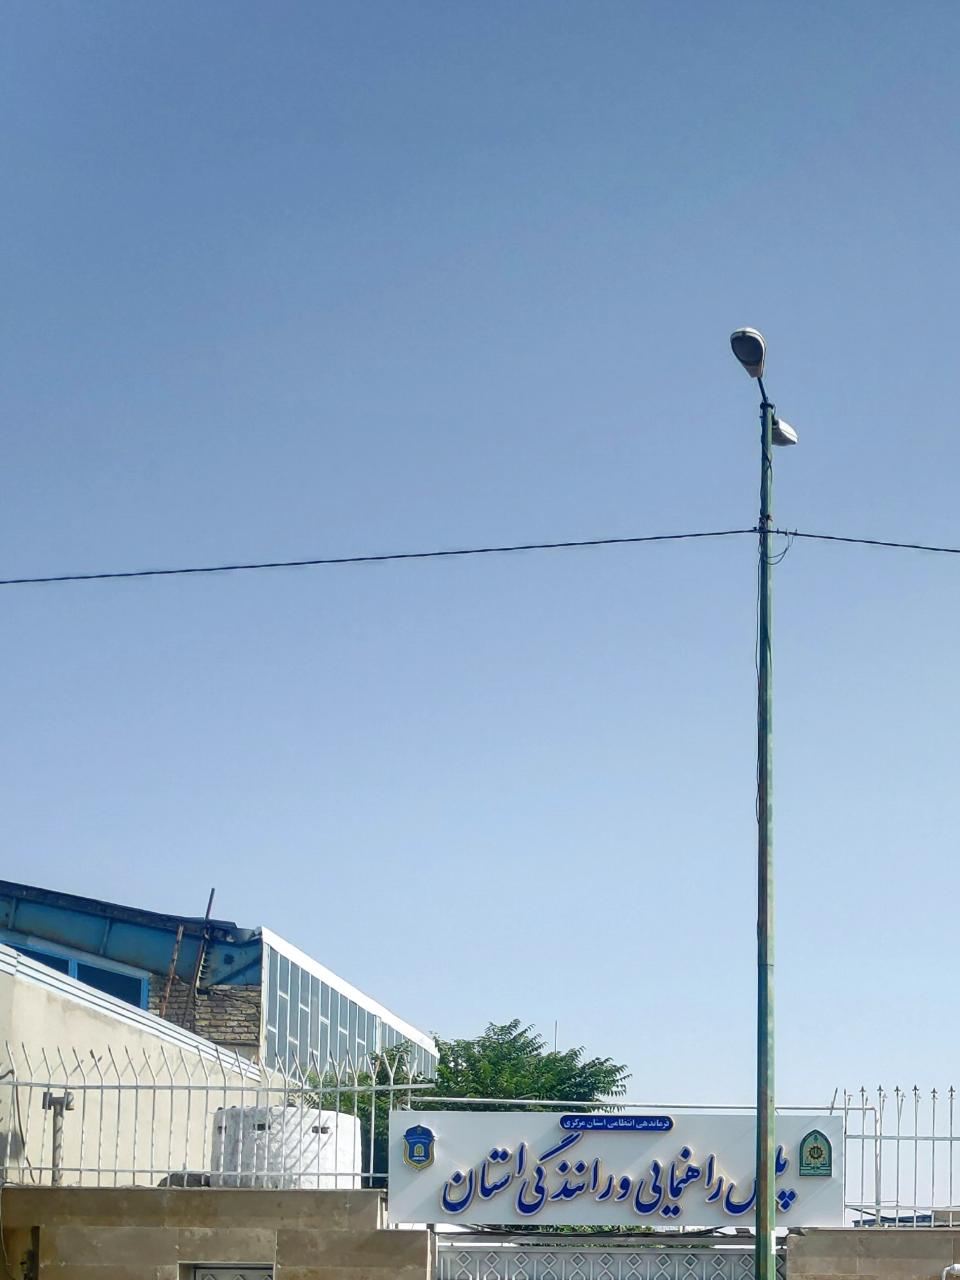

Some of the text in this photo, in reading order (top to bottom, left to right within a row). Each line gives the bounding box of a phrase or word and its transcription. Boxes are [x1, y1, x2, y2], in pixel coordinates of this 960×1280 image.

[563, 1118, 670, 1129] فرماندهی انتظامی استان مرکزی
[438, 1142, 528, 1214] استان
[632, 1145, 724, 1218] راهنمایی
[723, 1145, 798, 1216] پلس
